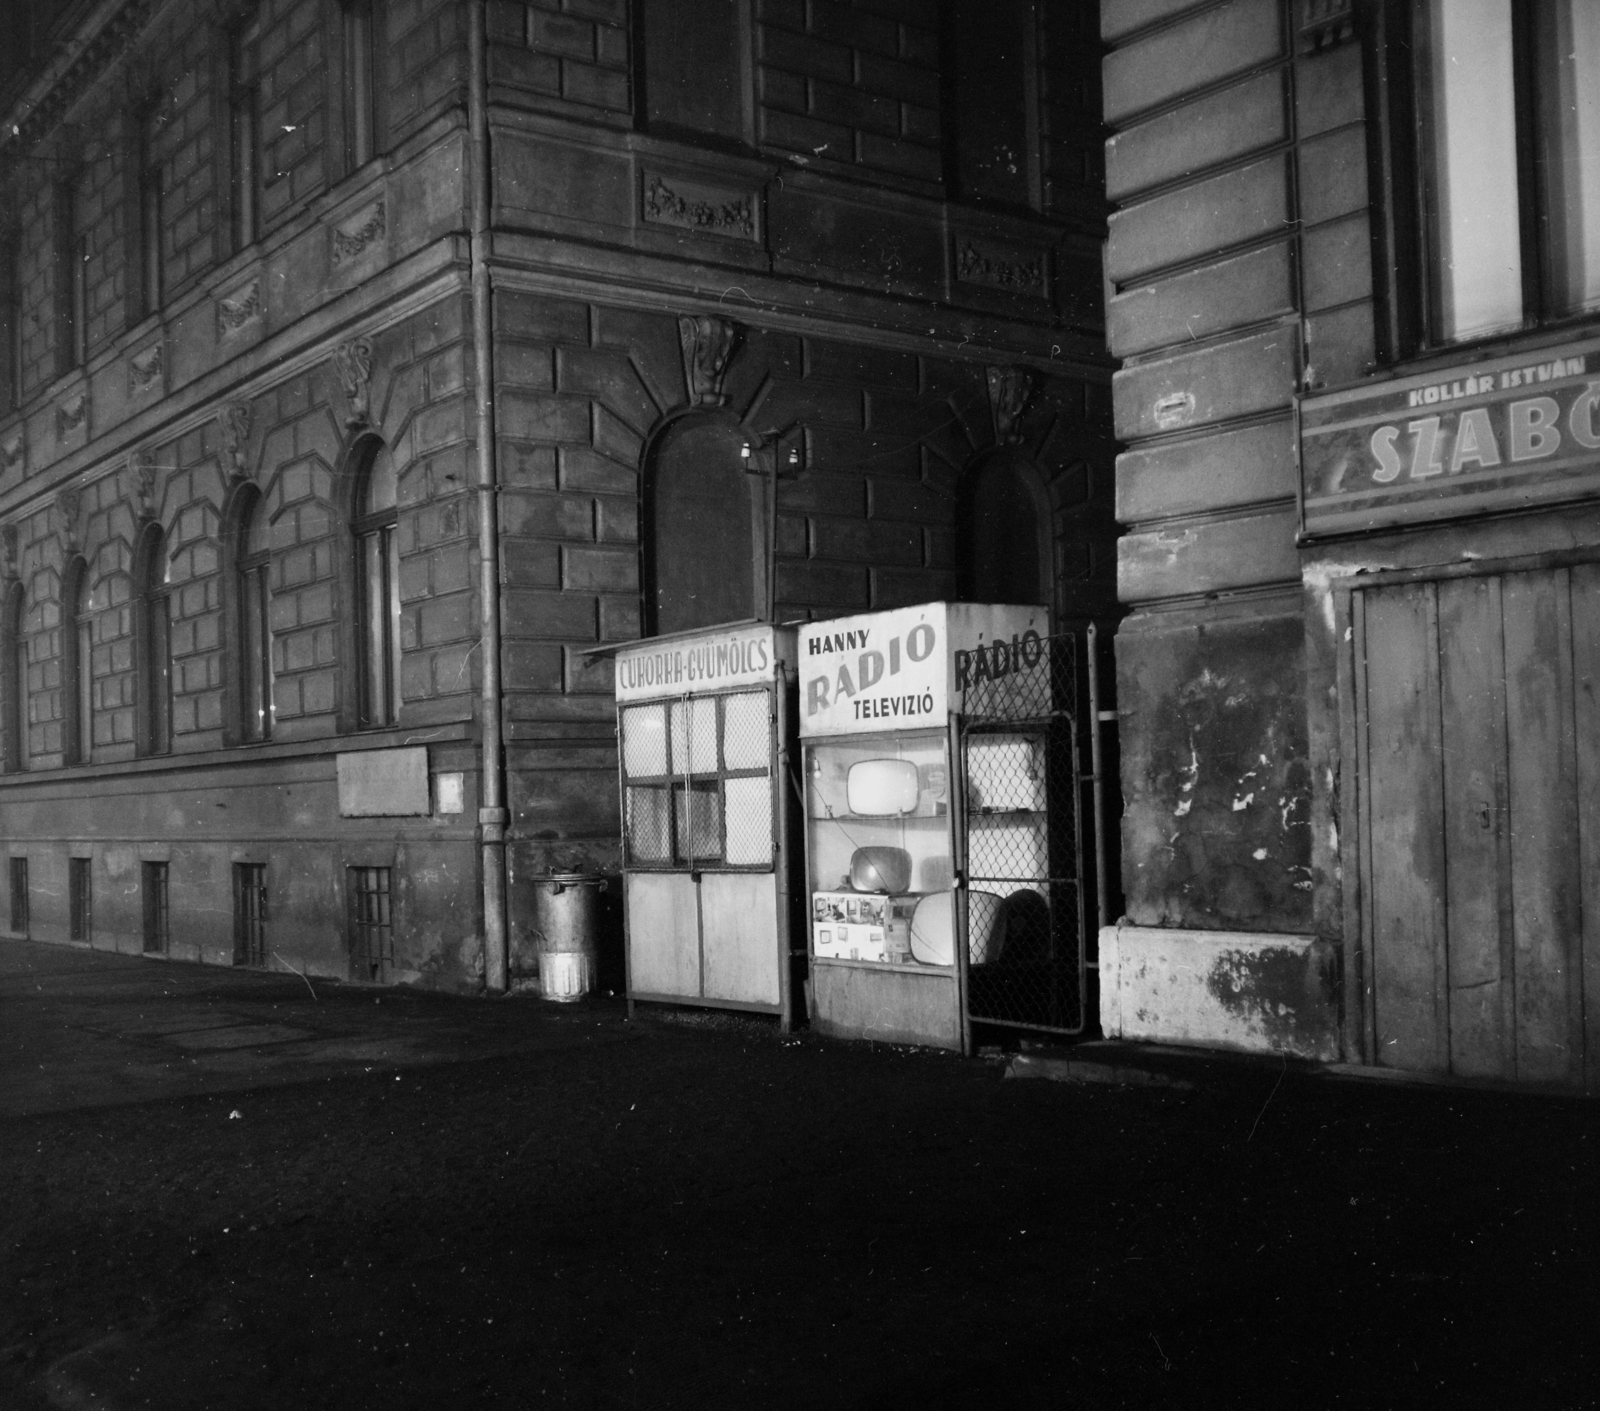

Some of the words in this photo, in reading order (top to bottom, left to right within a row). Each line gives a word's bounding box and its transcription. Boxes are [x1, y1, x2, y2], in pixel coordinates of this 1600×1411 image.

[807, 614, 936, 717] RÁDIÓ
[808, 629, 870, 655] HANNY
[954, 618, 1042, 692] RÁDIÓ
[853, 686, 934, 720] TELEVIZIÓ
